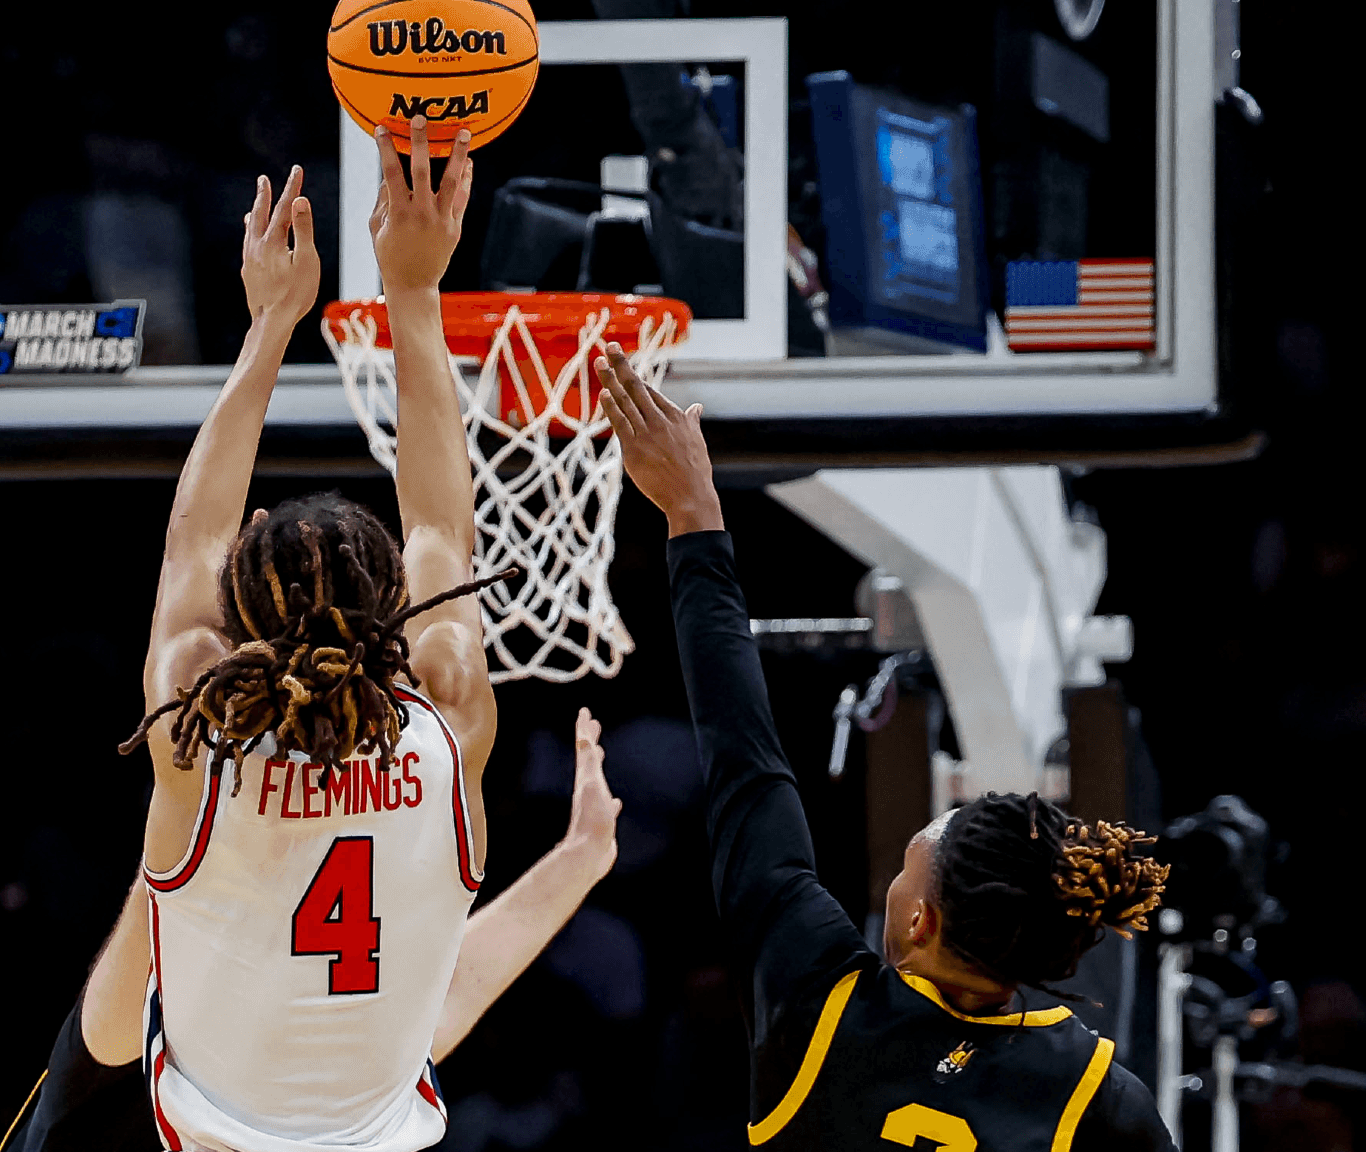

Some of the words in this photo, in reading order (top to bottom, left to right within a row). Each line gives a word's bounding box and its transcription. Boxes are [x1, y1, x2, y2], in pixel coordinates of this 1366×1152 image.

[367, 17, 507, 56] Wilson
[389, 89, 489, 121] NCAA
[4, 310, 97, 342] MARCH
[14, 337, 135, 370] MADNESS
[257, 752, 422, 819] FLEMINGS
[291, 835, 381, 995] 4
